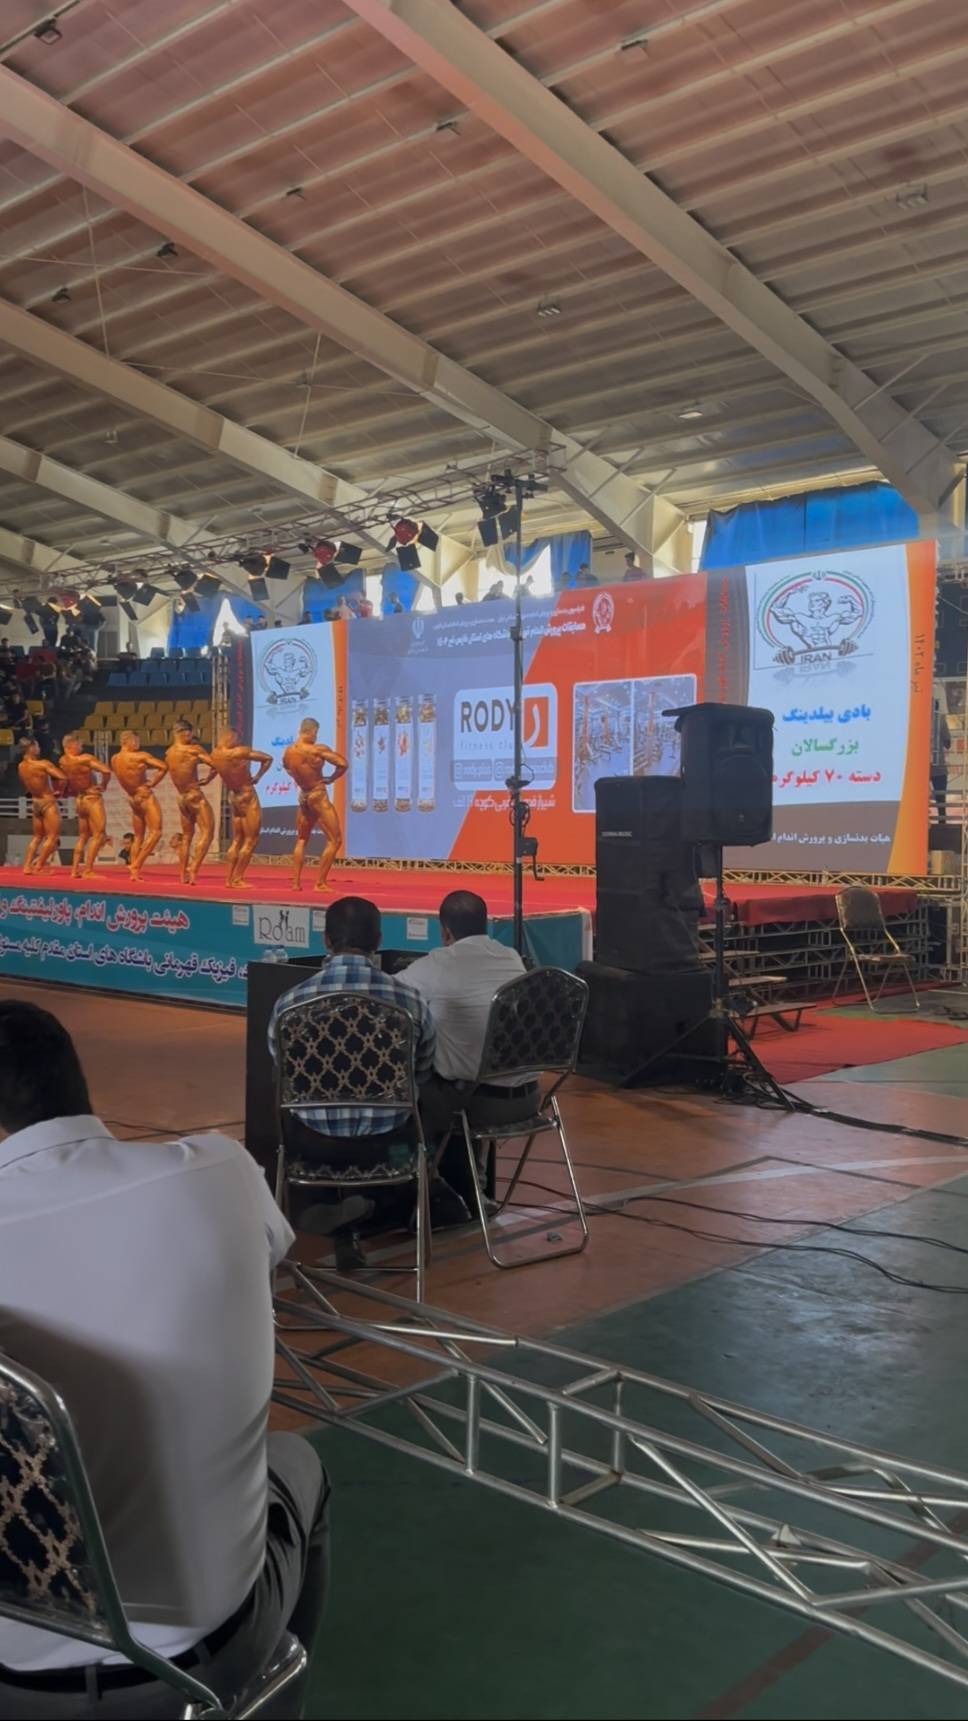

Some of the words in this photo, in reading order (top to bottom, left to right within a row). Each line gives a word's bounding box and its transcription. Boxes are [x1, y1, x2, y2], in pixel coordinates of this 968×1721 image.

[801, 652, 832, 664] IRAN
[460, 698, 515, 733] RODY
[838, 704, 871, 723] بادی
[848, 770, 881, 784] دسته
[106, 904, 148, 934] پرورش
[149, 909, 190, 934] هیئت
[65, 941, 95, 961] استان
[94, 944, 119, 966] های
[119, 946, 153, 972] باشگاه
[153, 951, 199, 979] قهرمانی
[200, 956, 236, 983] فیزیک
